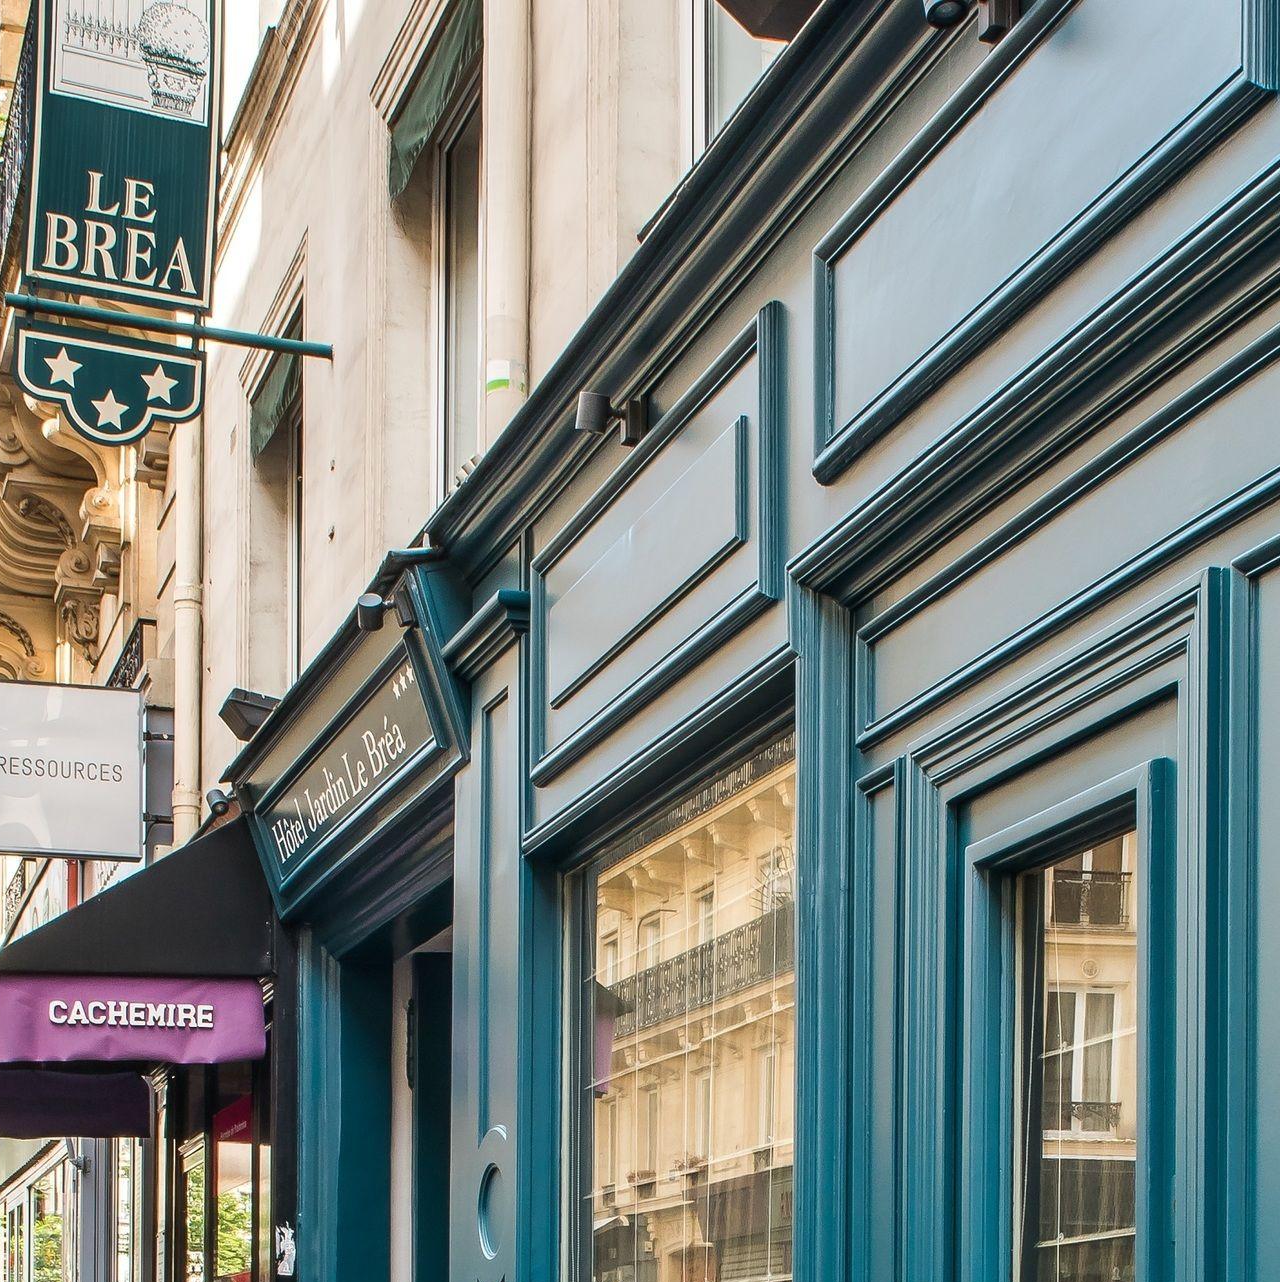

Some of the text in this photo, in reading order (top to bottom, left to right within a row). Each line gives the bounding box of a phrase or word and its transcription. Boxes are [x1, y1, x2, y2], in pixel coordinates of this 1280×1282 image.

[84, 170, 157, 224] LE
[41, 211, 198, 295] BREA
[272, 715, 407, 864] Hôtel Jardin Le Bréa
[48, 1000, 215, 1029] CACHEMIRE
